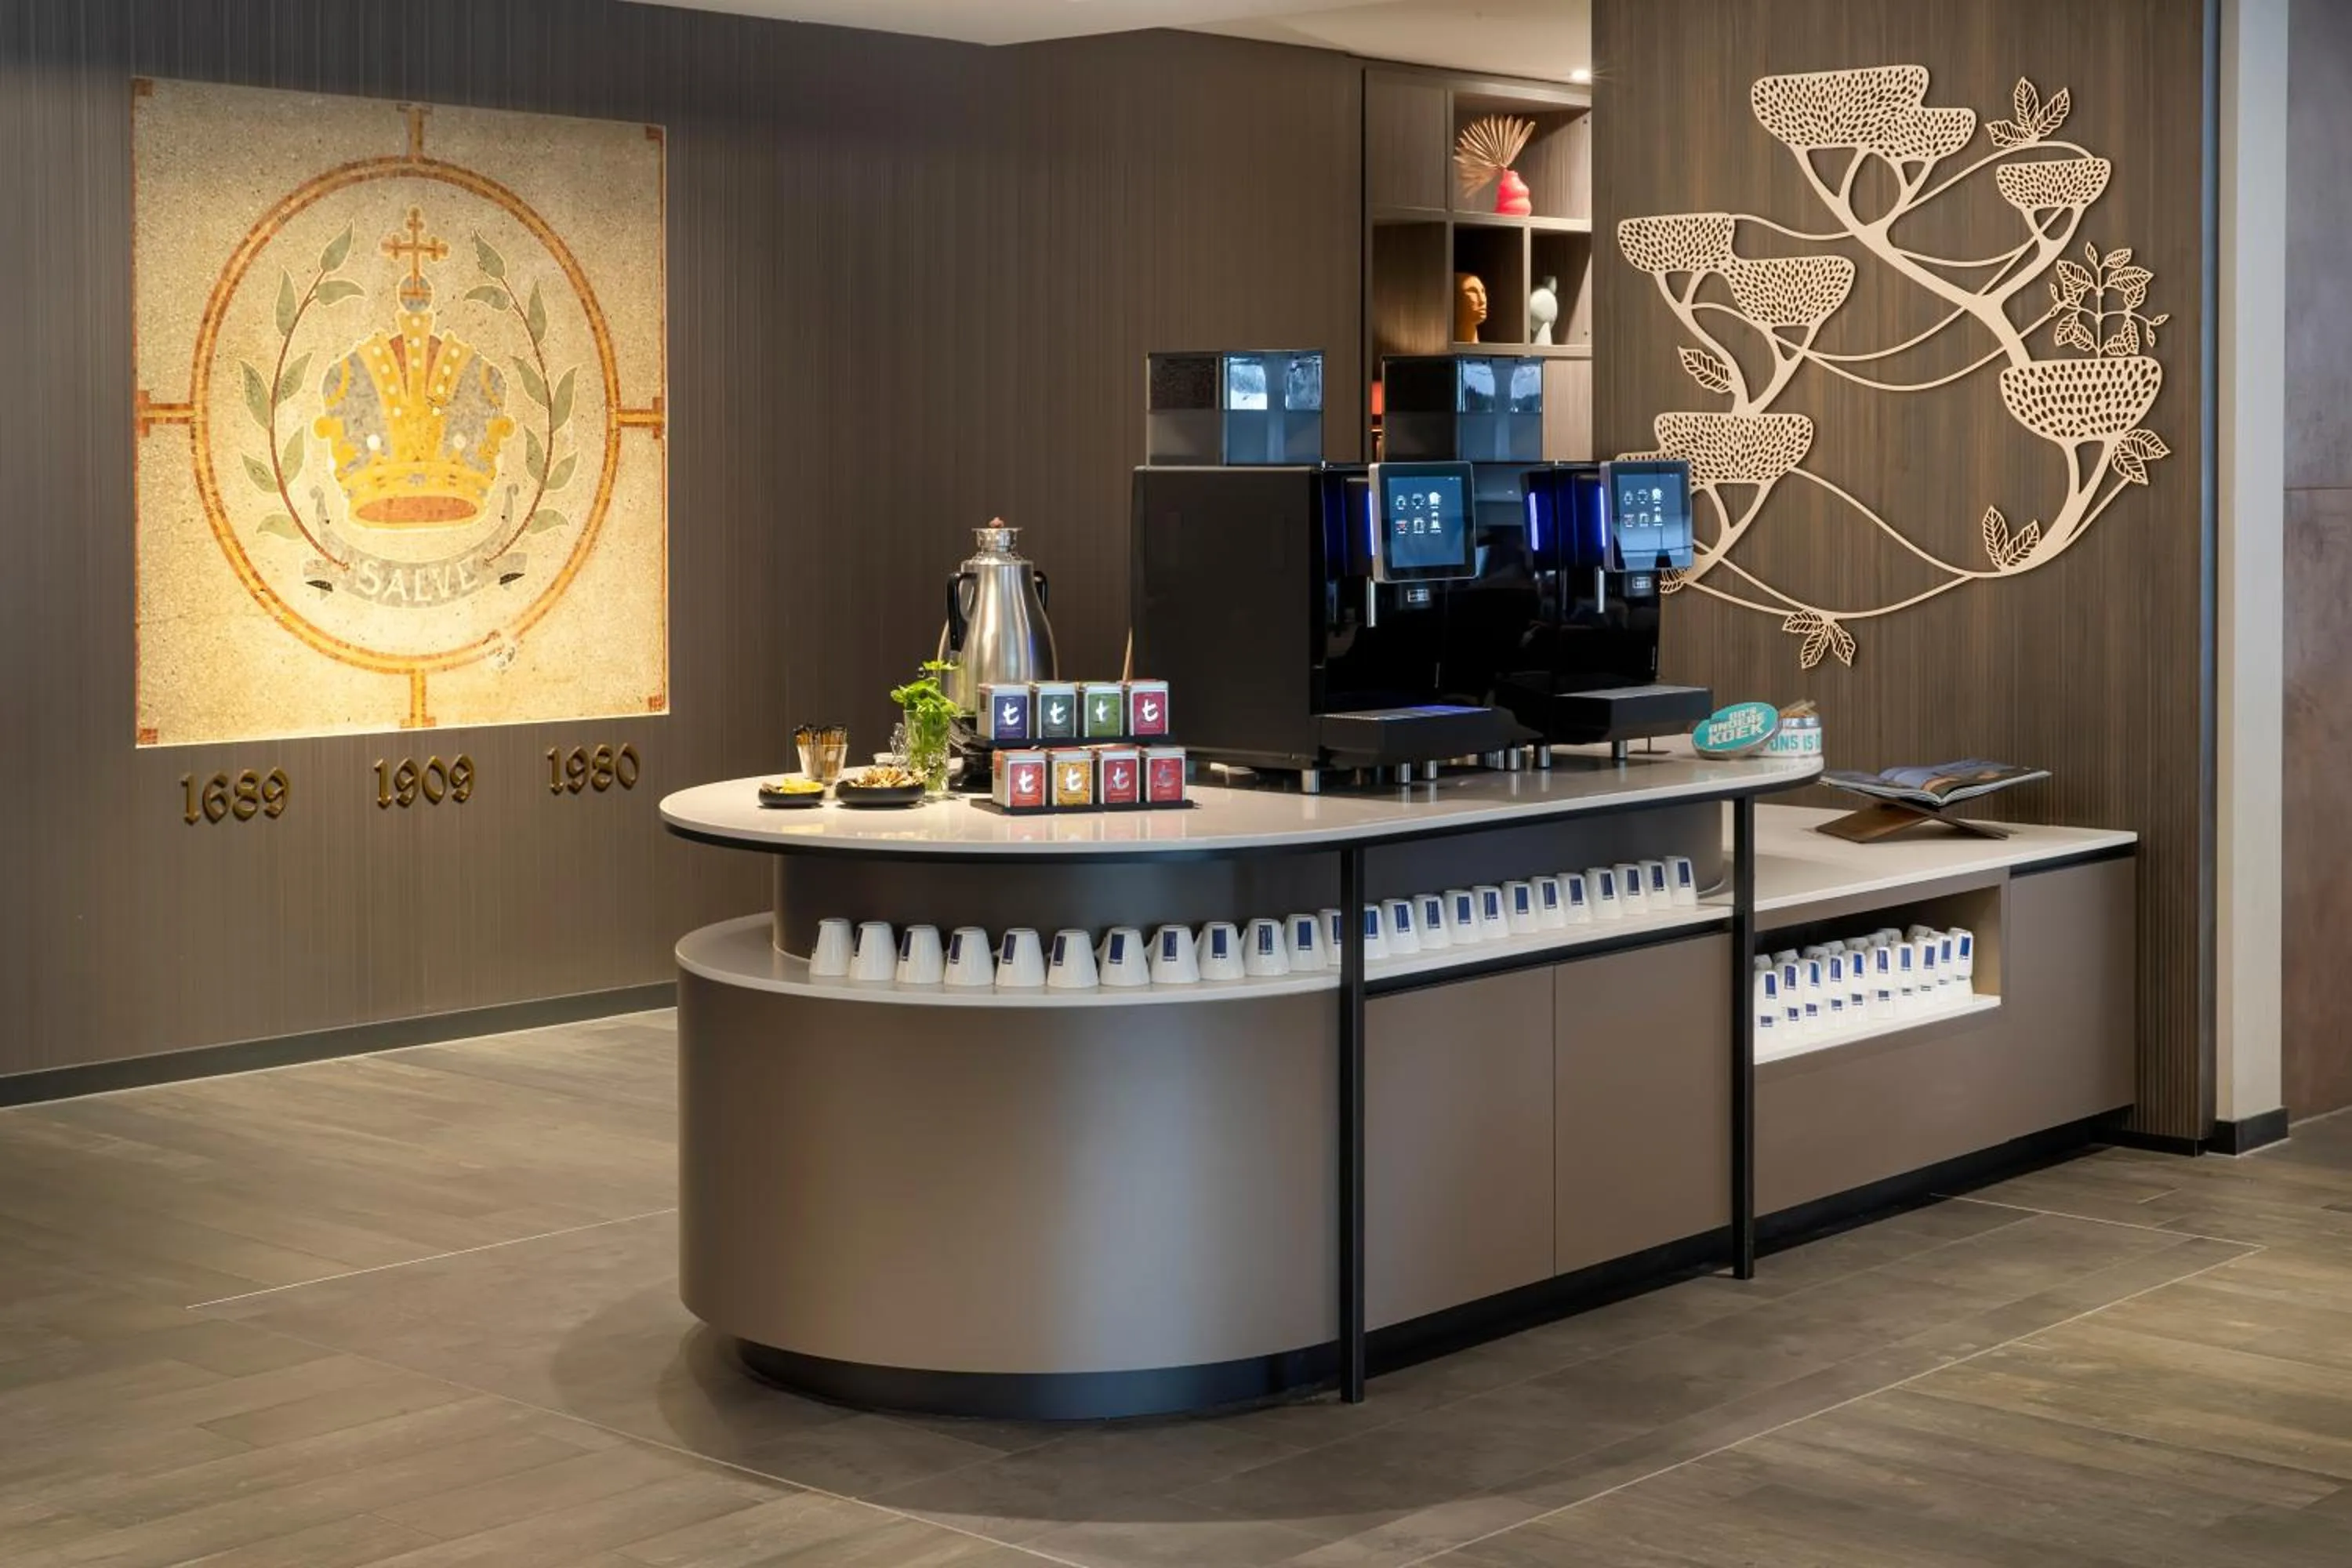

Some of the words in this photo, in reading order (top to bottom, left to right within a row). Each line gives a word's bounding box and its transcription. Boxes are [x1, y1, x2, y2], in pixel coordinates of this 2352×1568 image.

[355, 556, 478, 602] SALVE
[1708, 724, 1764, 746] KOEK
[180, 766, 289, 826] 1689
[373, 753, 475, 810] 1909
[546, 742, 641, 796] 1980
